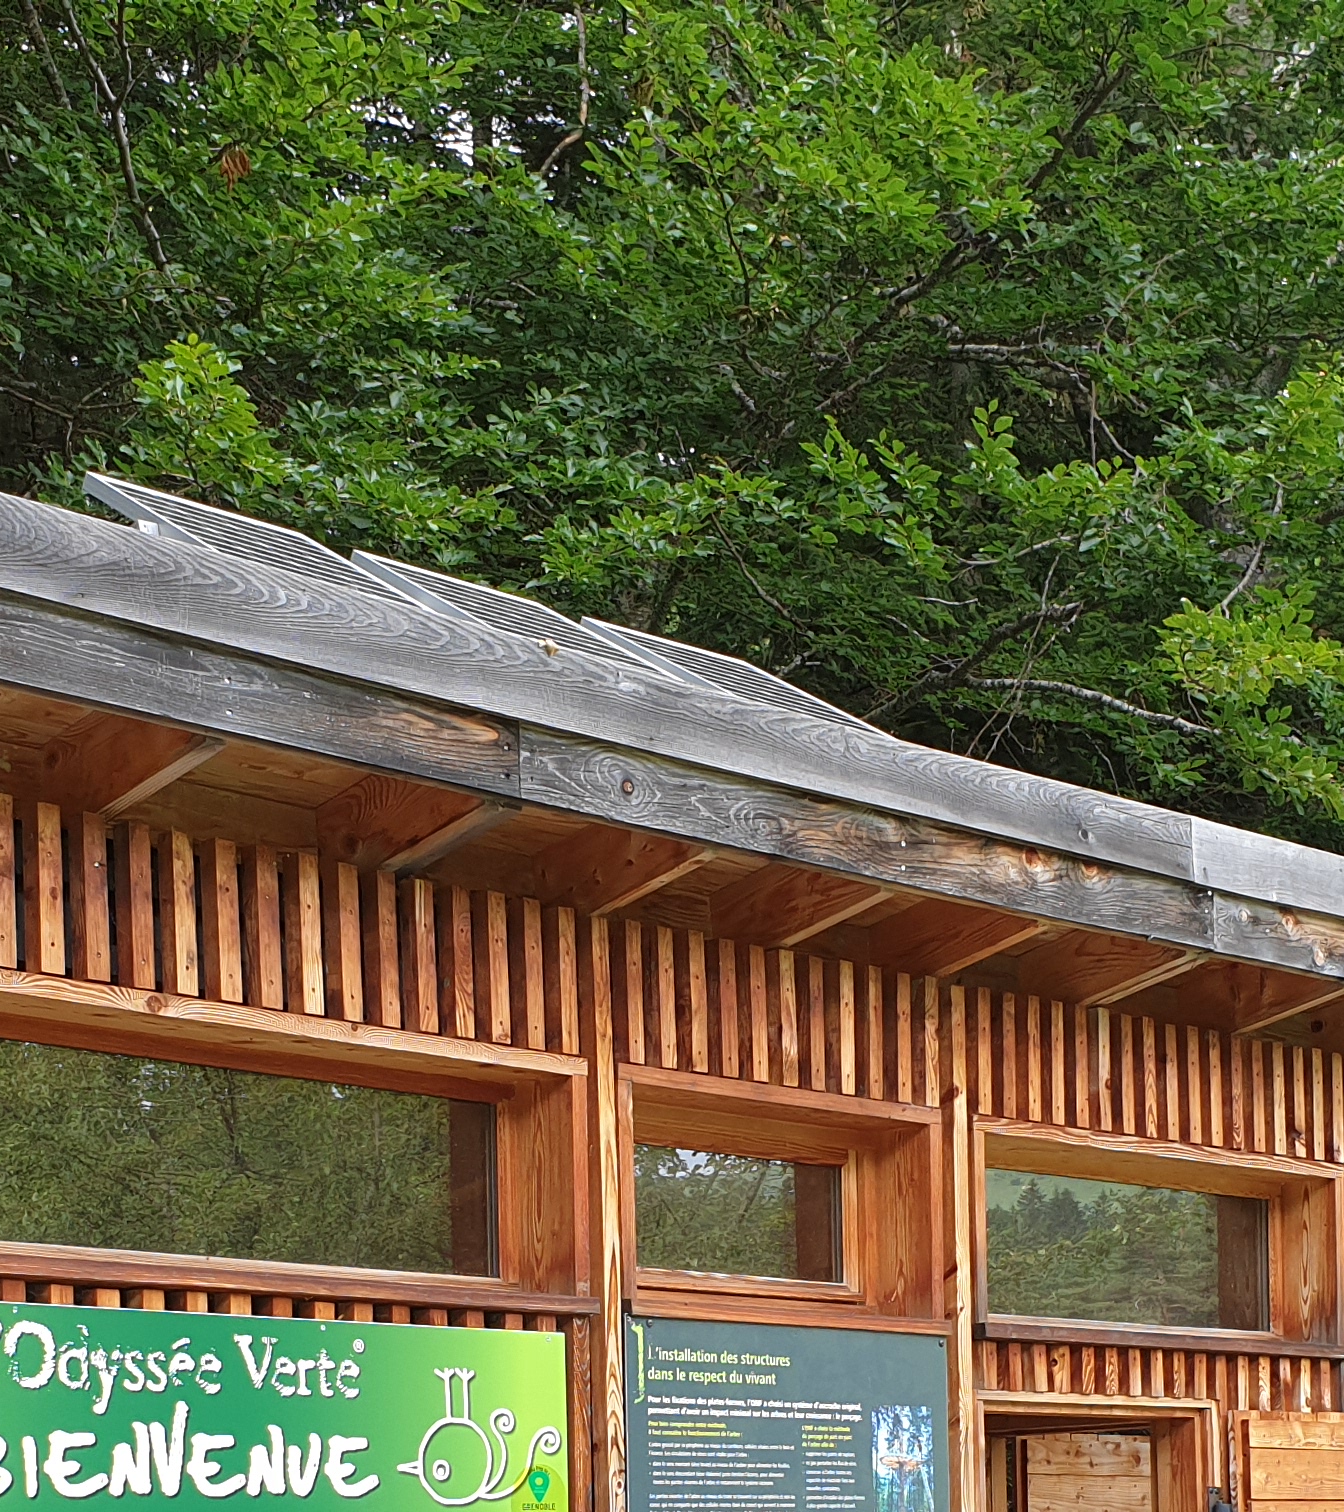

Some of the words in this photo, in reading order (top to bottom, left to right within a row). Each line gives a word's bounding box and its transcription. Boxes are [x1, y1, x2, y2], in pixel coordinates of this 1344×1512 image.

[720, 1350, 738, 1364] des
[740, 1353, 791, 1367] structures
[647, 1366, 673, 1380] dans
[676, 1367, 686, 1380] le
[688, 1371, 727, 1385] respect
[729, 1370, 742, 1384] du
[745, 1371, 776, 1385] vivant
